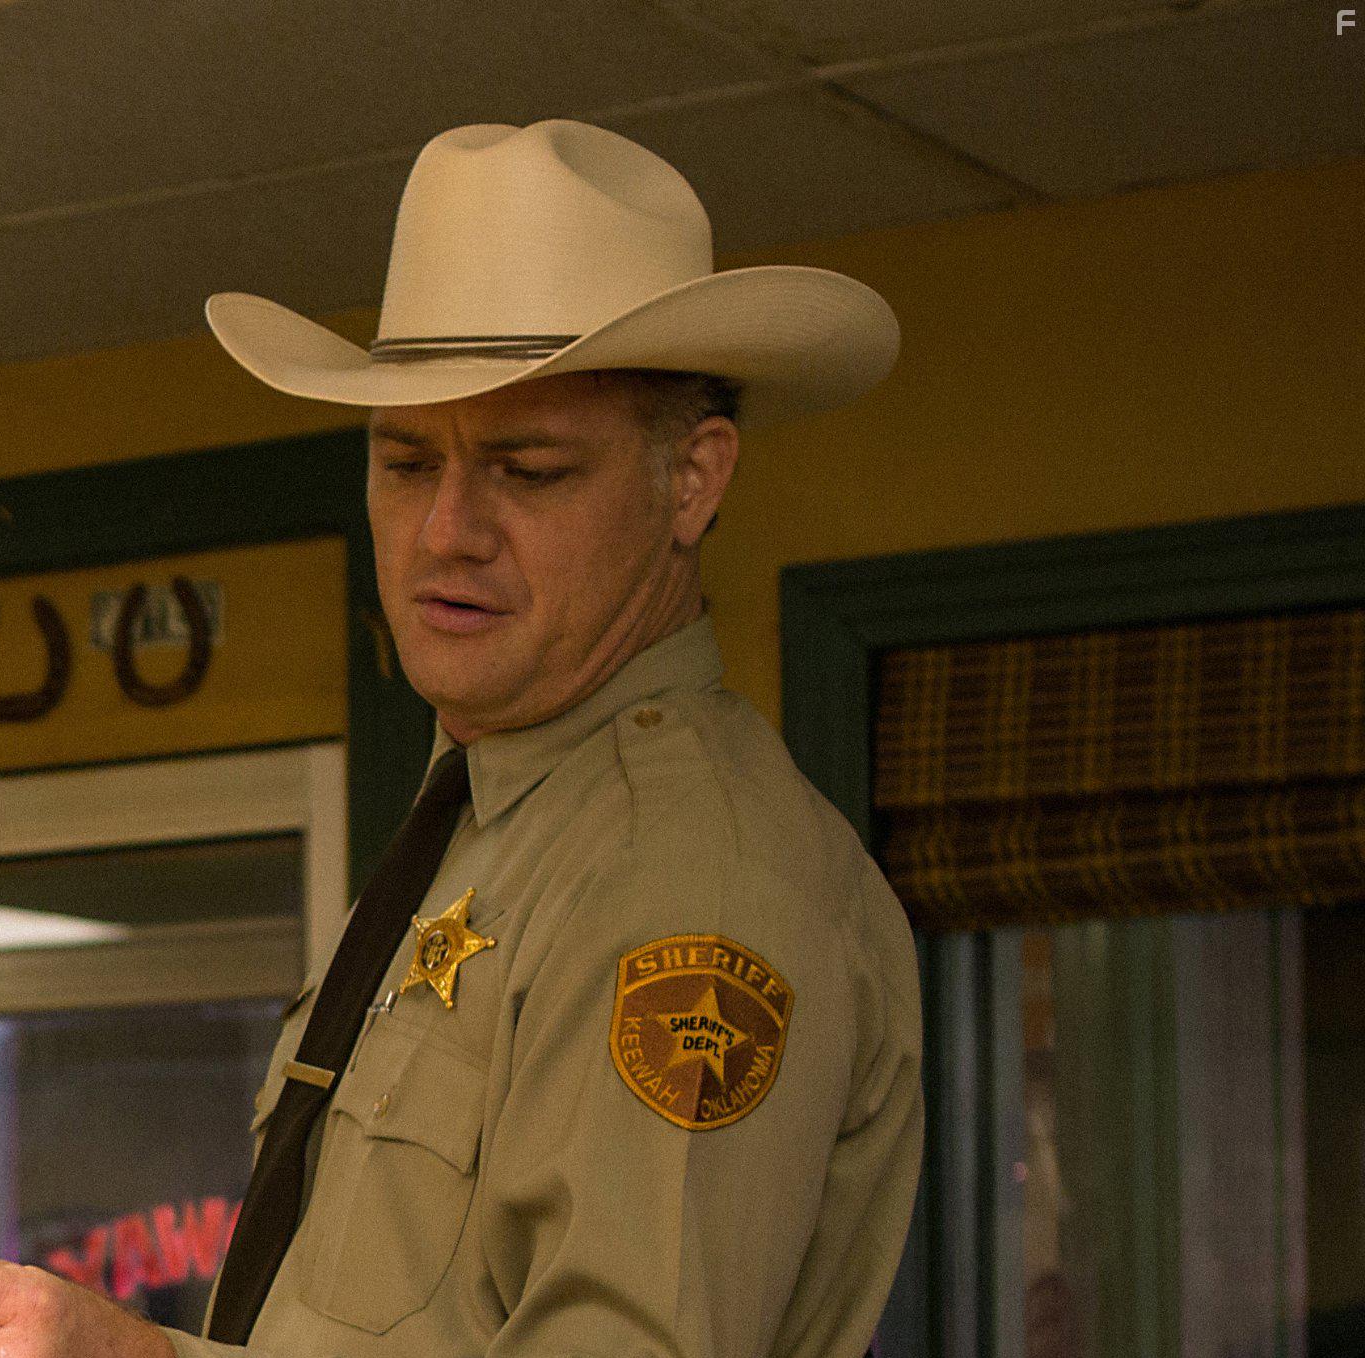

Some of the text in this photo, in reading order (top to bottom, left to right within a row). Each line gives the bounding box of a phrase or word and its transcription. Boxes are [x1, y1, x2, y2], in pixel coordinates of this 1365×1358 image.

[635, 947, 785, 996] SHERIFF
[622, 1016, 680, 1105] KEEWAH
[670, 1016, 735, 1046] SHERIFF'S
[700, 1045, 775, 1118] OKLAHOMA
